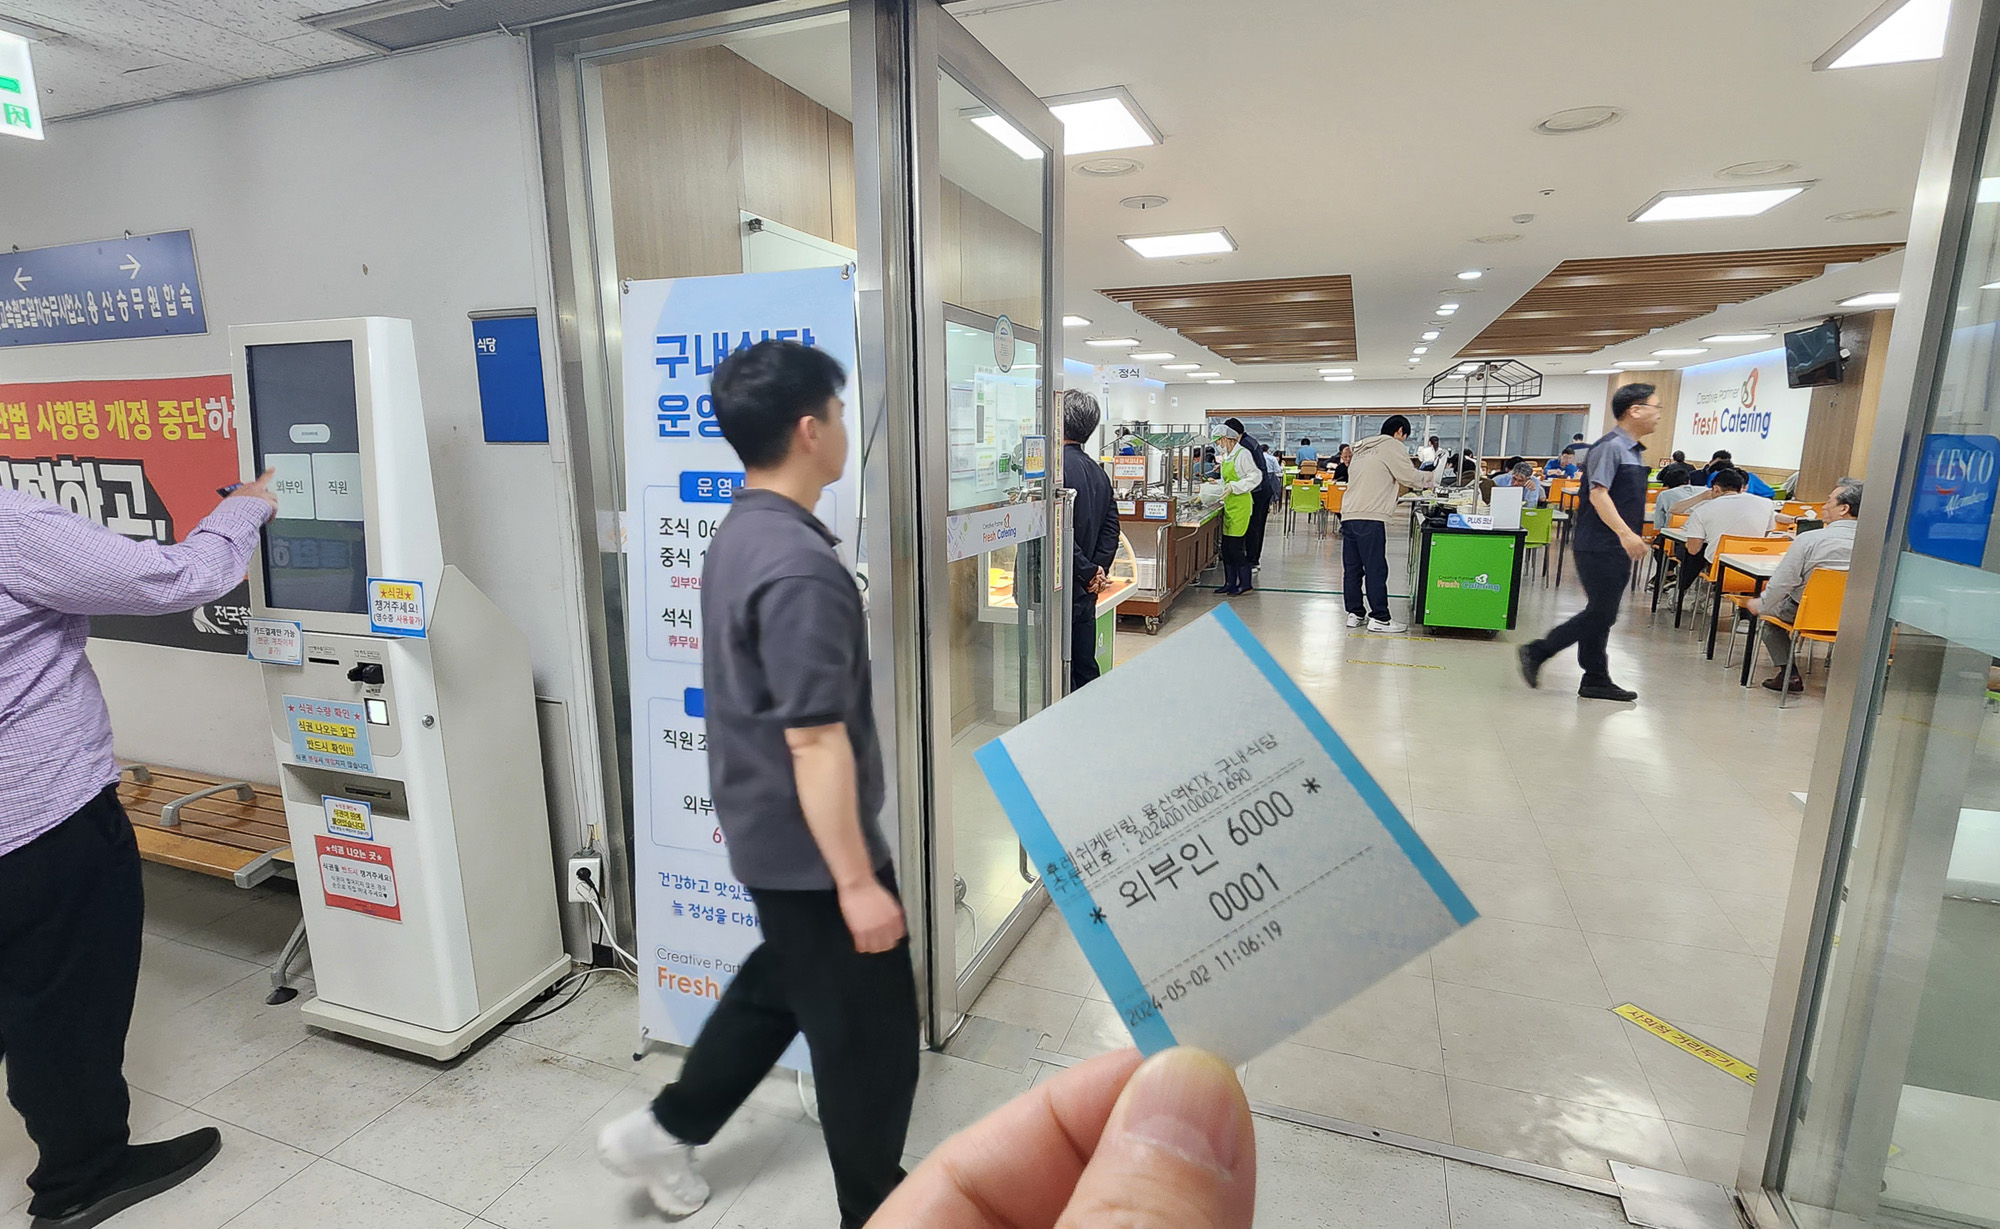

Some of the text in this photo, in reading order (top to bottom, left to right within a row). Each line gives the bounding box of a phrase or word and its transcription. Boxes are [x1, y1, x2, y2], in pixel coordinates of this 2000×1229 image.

[477, 337, 497, 353] 식당
[655, 328, 816, 379] 구내
[1118, 368, 1140, 379] 정식
[37, 399, 100, 440] 시행령
[104, 399, 152, 440] 개정
[157, 396, 239, 440] 중단하
[1692, 405, 1772, 440] Fresh Catering
[1936, 448, 1994, 485] CESCO
[276, 480, 304, 495] 외부인
[328, 480, 348, 495] 직원
[659, 517, 690, 538] 조식
[1467, 516, 1482, 525] PLUS
[982, 527, 1017, 543] Fresh Catering
[660, 547, 691, 568] 중식
[387, 587, 404, 600] 식권
[1437, 580, 1501, 593] Fresh Catering
[374, 600, 419, 614] 챙겨주세요!
[662, 607, 693, 629] 석식
[668, 635, 699, 650] 휴무일
[298, 703, 314, 715] 식권
[316, 705, 332, 717] 수량
[298, 720, 356, 738] 식권 나오는 입구
[663, 728, 694, 751] 직원
[306, 739, 329, 752] 반드시
[1214, 733, 1279, 775] 구내식당
[683, 795, 715, 816] 외부
[1118, 790, 1294, 908] 외부인 6000
[658, 871, 710, 894] 건강하고
[1208, 861, 1280, 922] 0001
[672, 899, 684, 917] 늘
[688, 902, 728, 926] 정성을
[656, 947, 712, 969] Creative
[657, 965, 721, 1001] Fresh
[1124, 919, 1283, 1028] 2024-05-02 11:06:19
[1671, 1033, 1737, 1069] 거리두기
